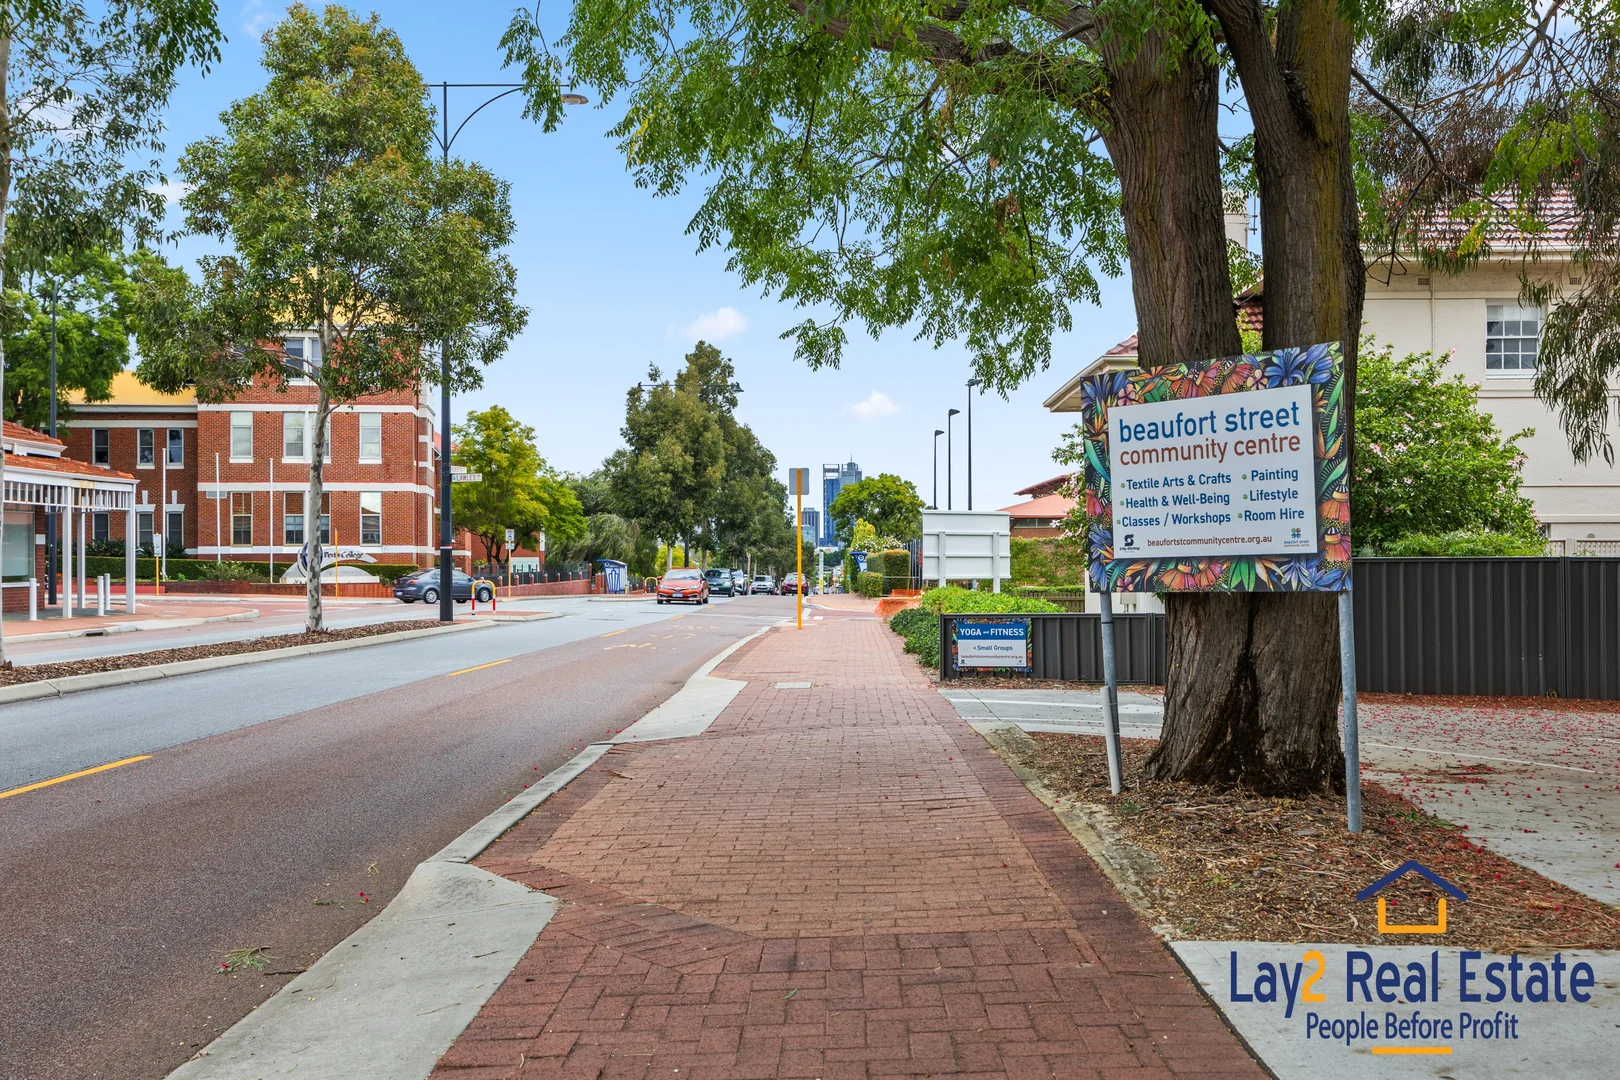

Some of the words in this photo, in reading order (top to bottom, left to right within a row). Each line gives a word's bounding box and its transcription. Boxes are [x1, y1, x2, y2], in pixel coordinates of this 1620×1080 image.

[1119, 409, 1217, 443] beaufort
[1225, 401, 1300, 433] street
[1119, 438, 1228, 466] community
[1233, 432, 1301, 457] centre
[1126, 477, 1160, 490] Textile
[1162, 475, 1185, 489] Arts
[1187, 474, 1196, 486] &
[1199, 472, 1232, 485] Crafts
[1251, 468, 1299, 482] Painting
[1125, 495, 1159, 509] Health
[1161, 494, 1170, 507] &
[1171, 492, 1230, 506] Well-Being
[1249, 488, 1299, 503] Lifestyle
[1121, 515, 1160, 528] Classes
[1163, 512, 1169, 527] /
[1171, 511, 1231, 525] Workshops
[1244, 510, 1276, 522] Room
[1279, 508, 1305, 520] Hire
[1147, 535, 1273, 547] beaufortstcommunitycentre.org.au
[960, 628, 982, 636] YOGA
[990, 628, 1024, 636] FITNESS
